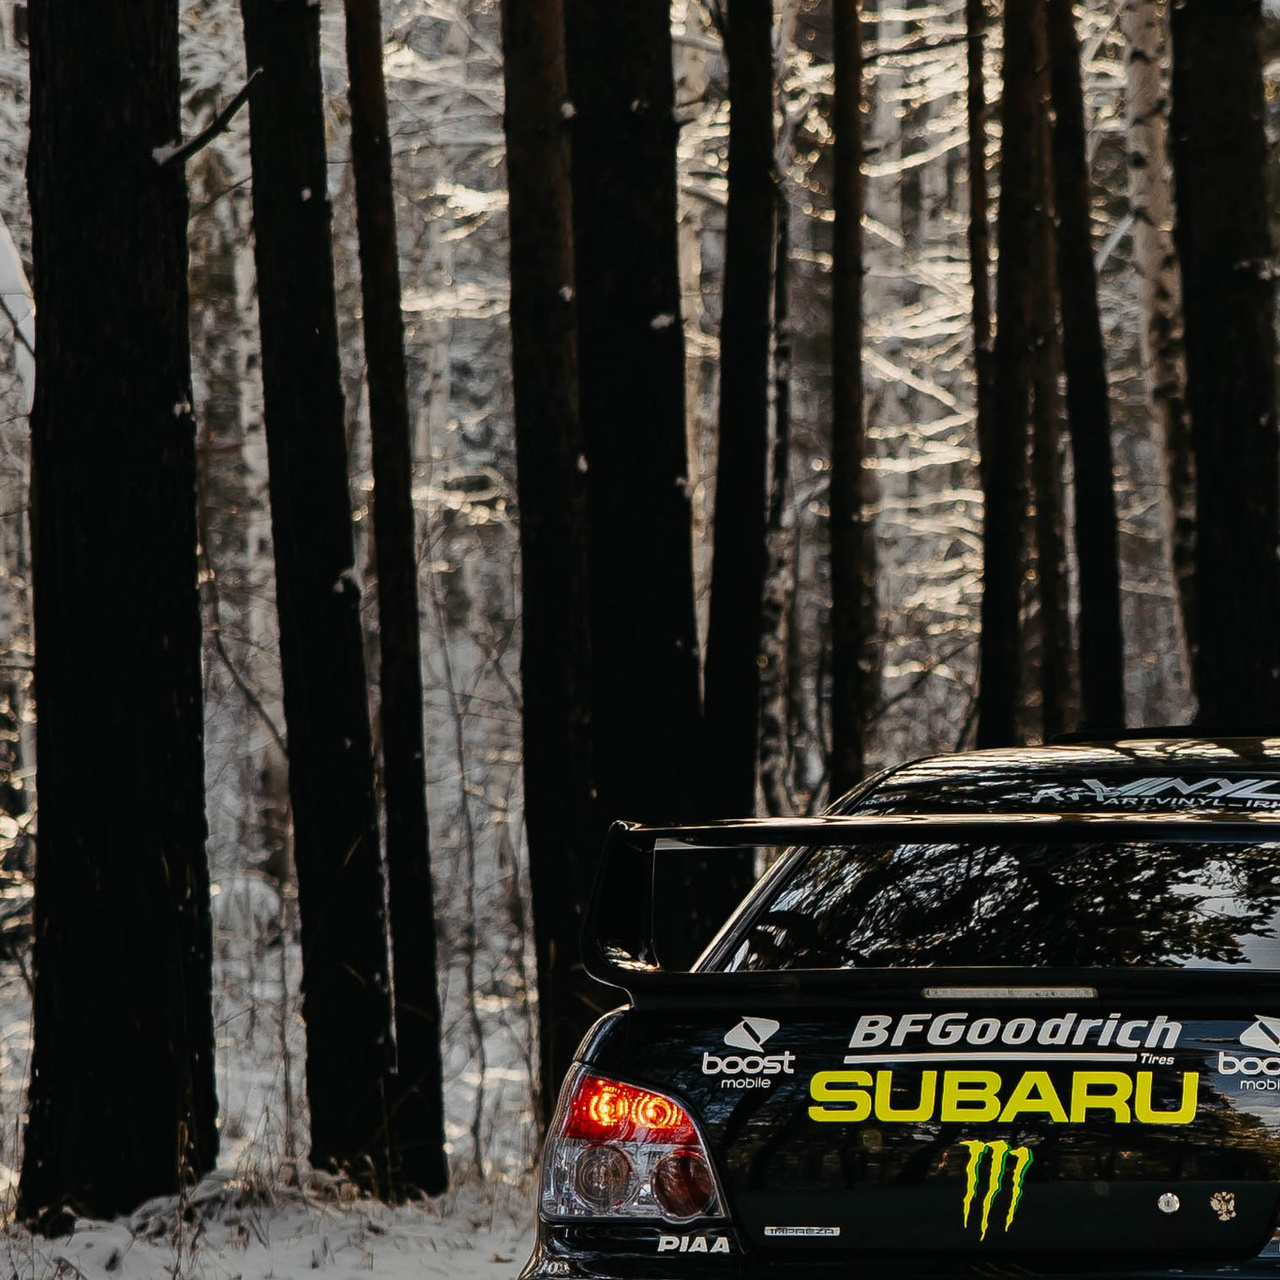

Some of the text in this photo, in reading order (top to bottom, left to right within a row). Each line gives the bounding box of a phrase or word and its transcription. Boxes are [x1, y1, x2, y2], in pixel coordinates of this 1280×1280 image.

[848, 1013, 1183, 1049] BFGoodrich
[702, 1051, 796, 1074] boost
[1140, 1053, 1174, 1065] Tires
[721, 1077, 771, 1089] mobile
[808, 1070, 1199, 1124] SUBARU
[657, 1236, 730, 1253] PIAA
